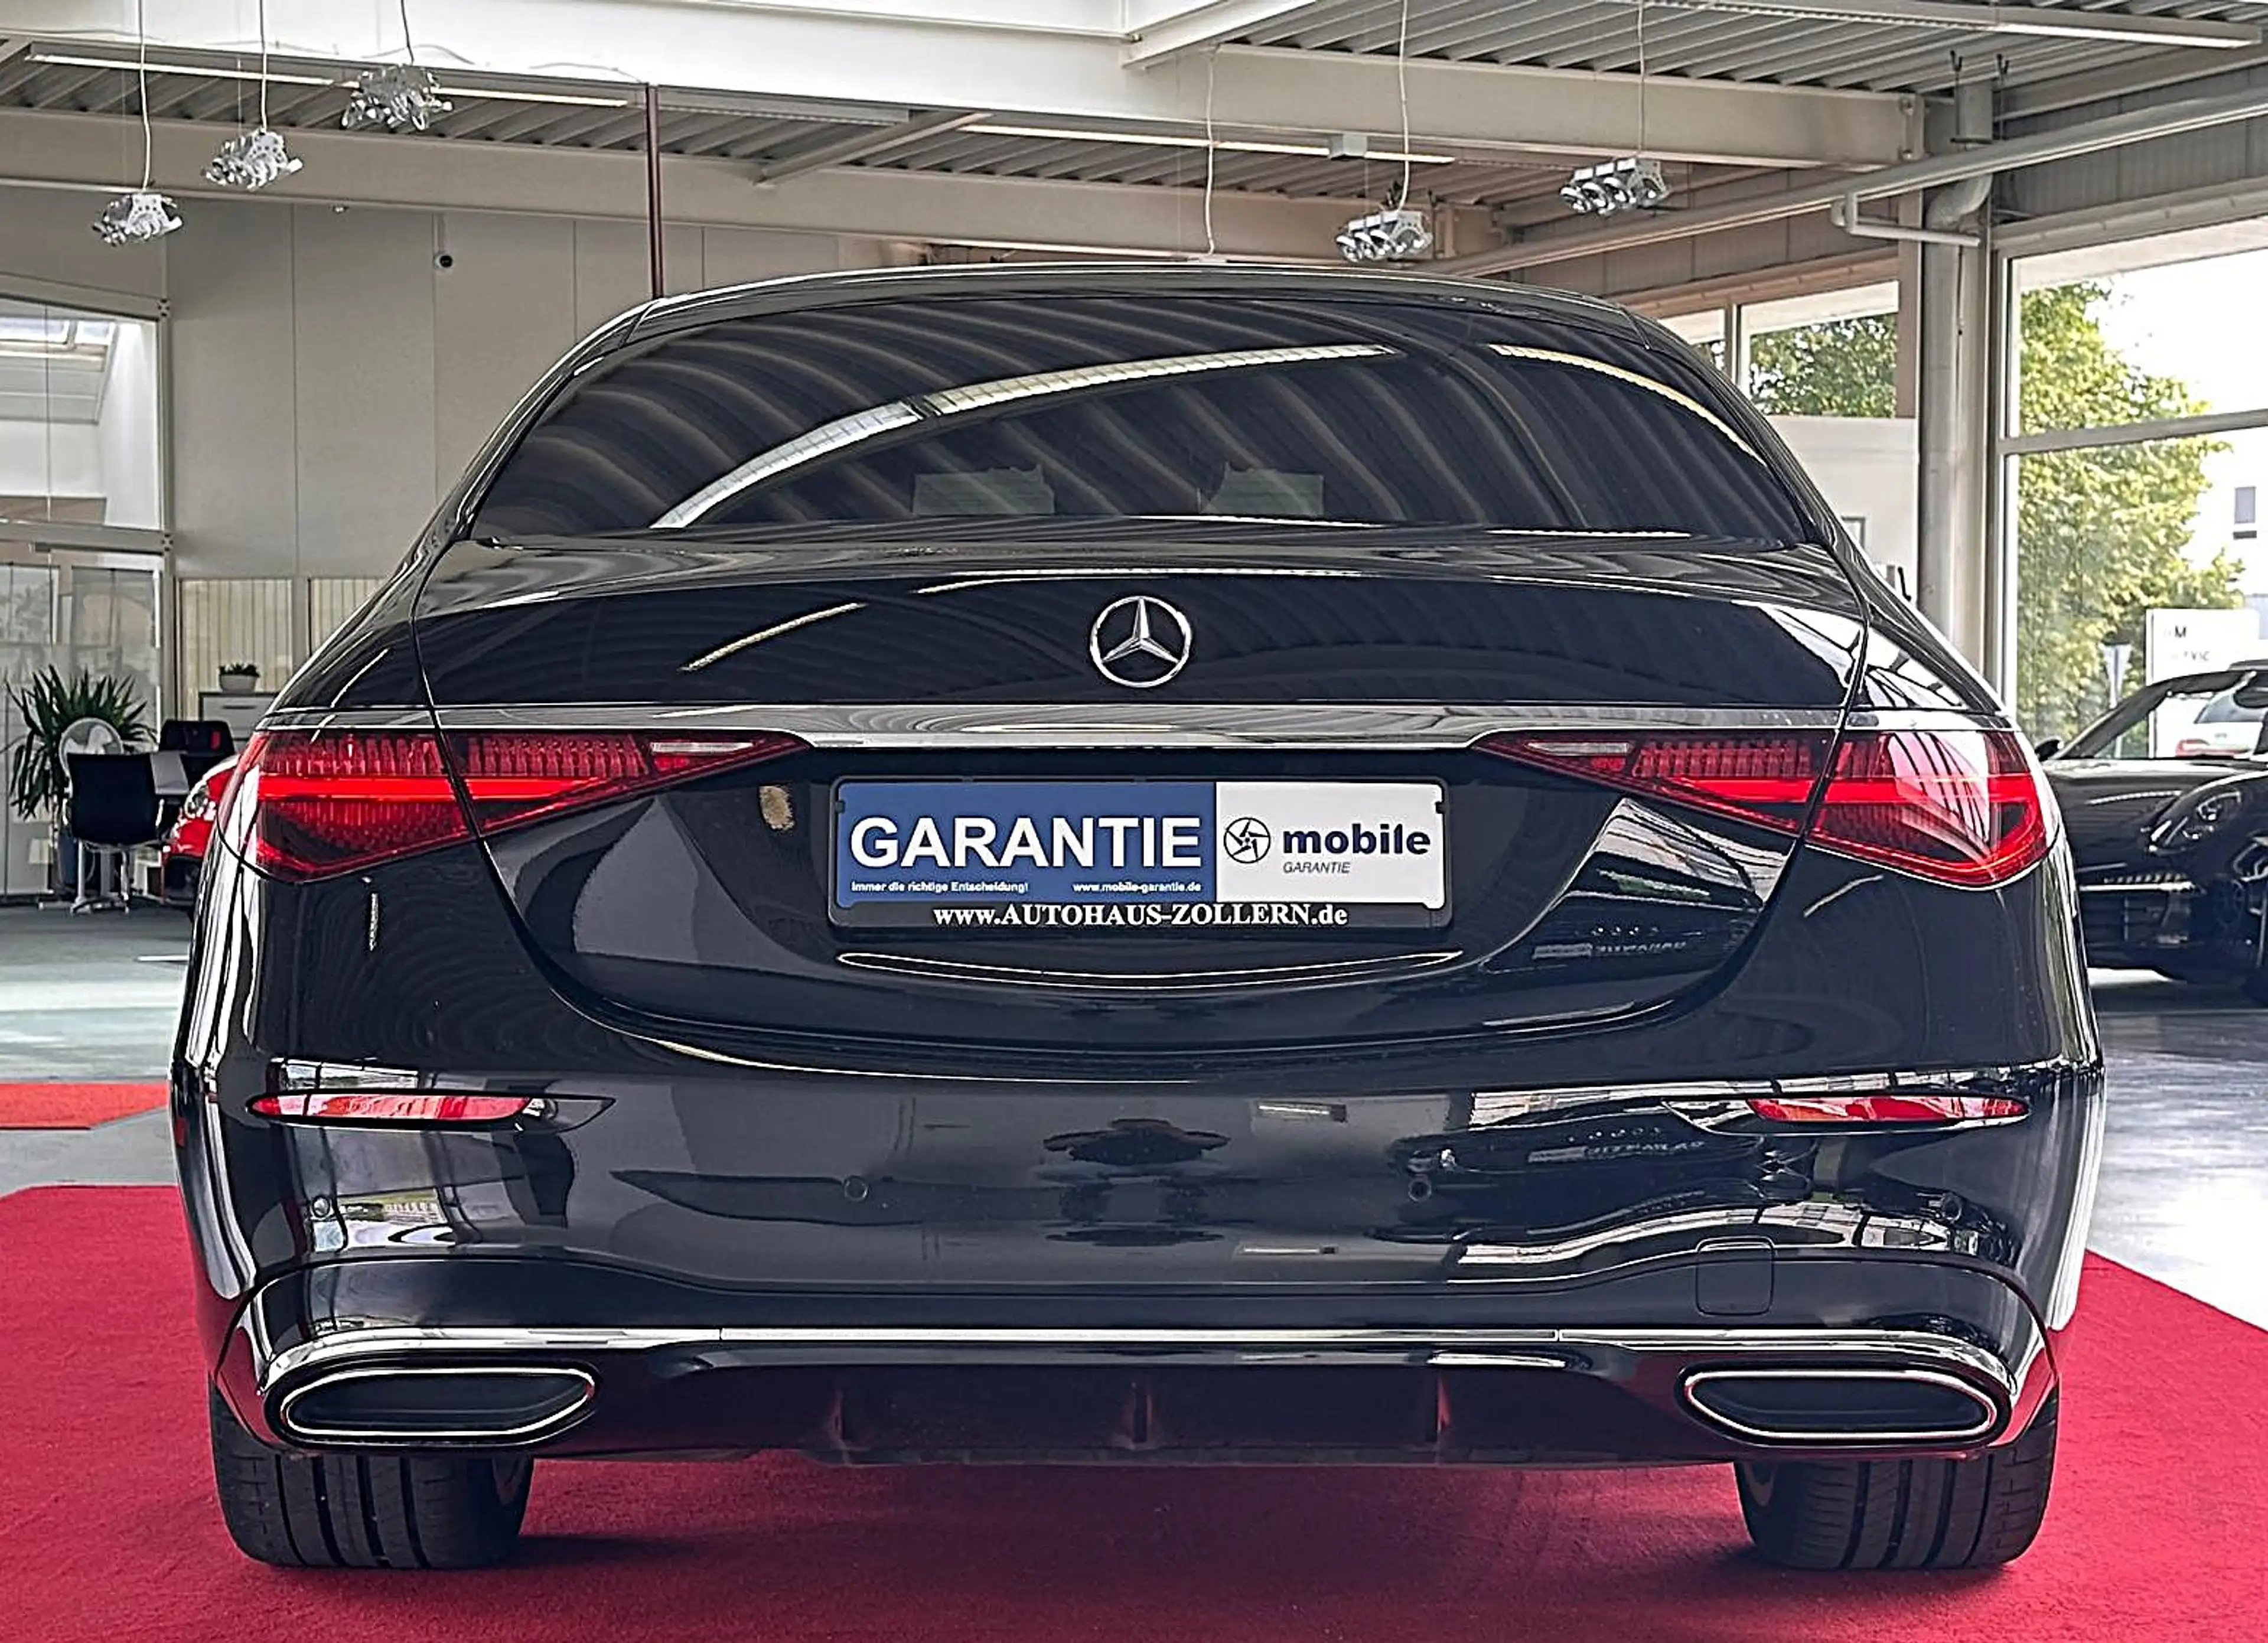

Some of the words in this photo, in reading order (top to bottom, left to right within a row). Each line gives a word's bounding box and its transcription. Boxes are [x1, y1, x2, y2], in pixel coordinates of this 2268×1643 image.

[850, 817, 1201, 868] GARANTIE
[1283, 823, 1431, 855] mobile
[1283, 861, 1351, 873] GARANTIE
[851, 882, 887, 892] Immer
[888, 882, 905, 892] die
[908, 882, 948, 894] richtige
[951, 882, 1029, 894] Entscheidung!
[1073, 882, 1202, 894] www.mobile-garantie.de
[933, 904, 1348, 925] www.AUTOHAUS-ZOLLERN.de
